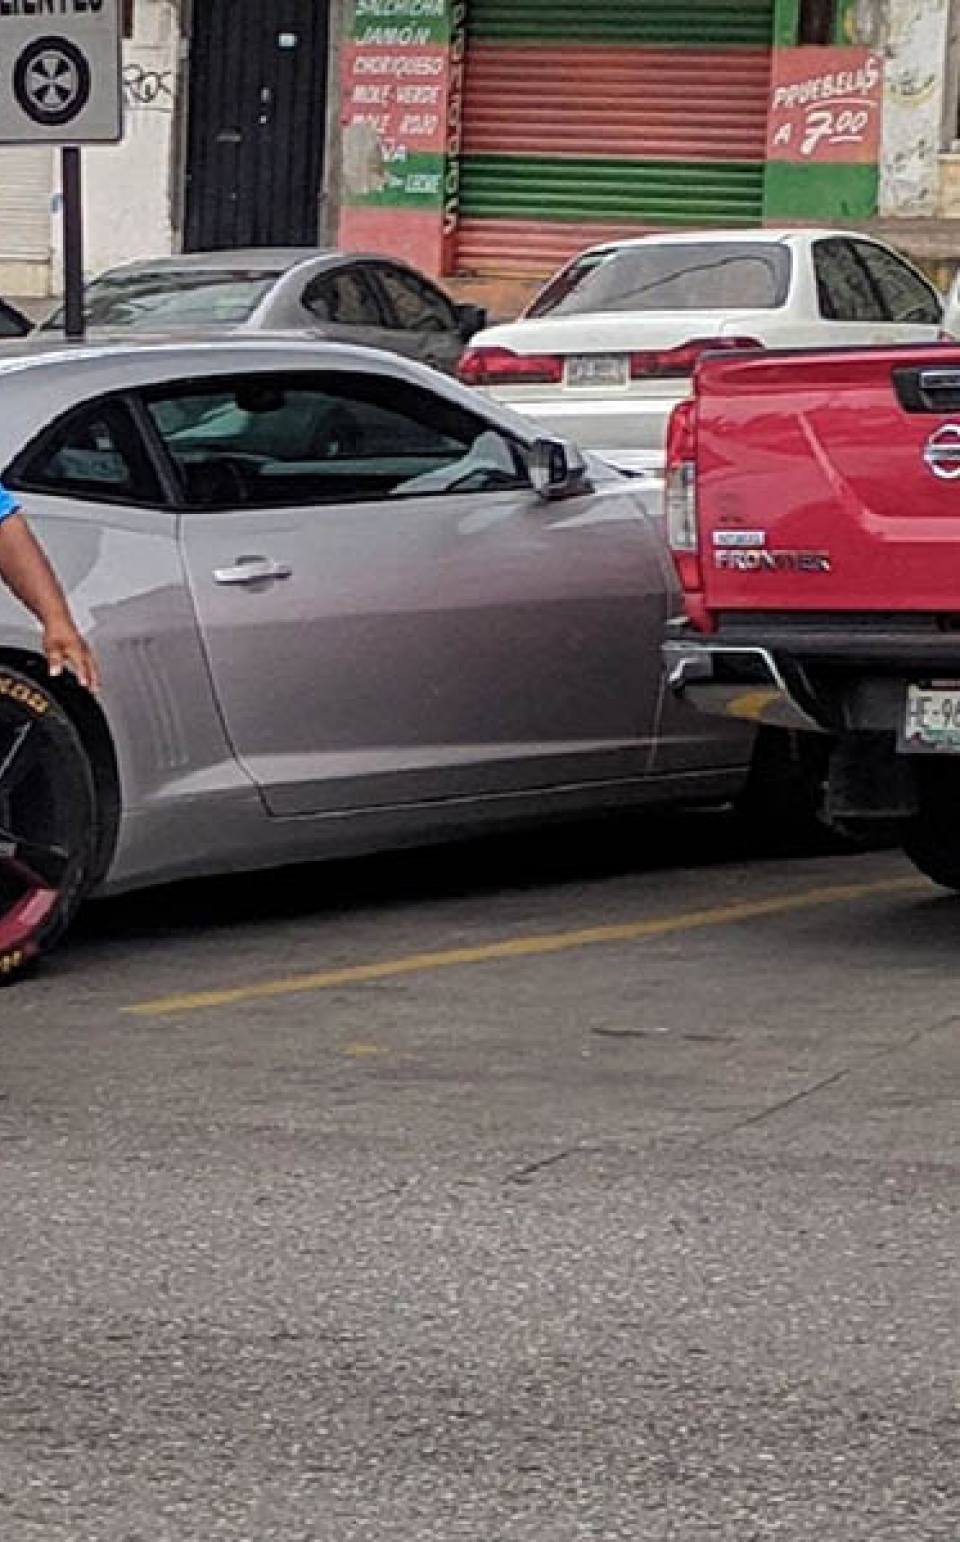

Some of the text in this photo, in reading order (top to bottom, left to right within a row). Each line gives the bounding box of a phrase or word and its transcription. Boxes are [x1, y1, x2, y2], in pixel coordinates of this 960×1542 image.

[355, 20, 431, 46] JAMÓN
[396, 84, 440, 103] VERDE
[773, 122, 791, 145] A
